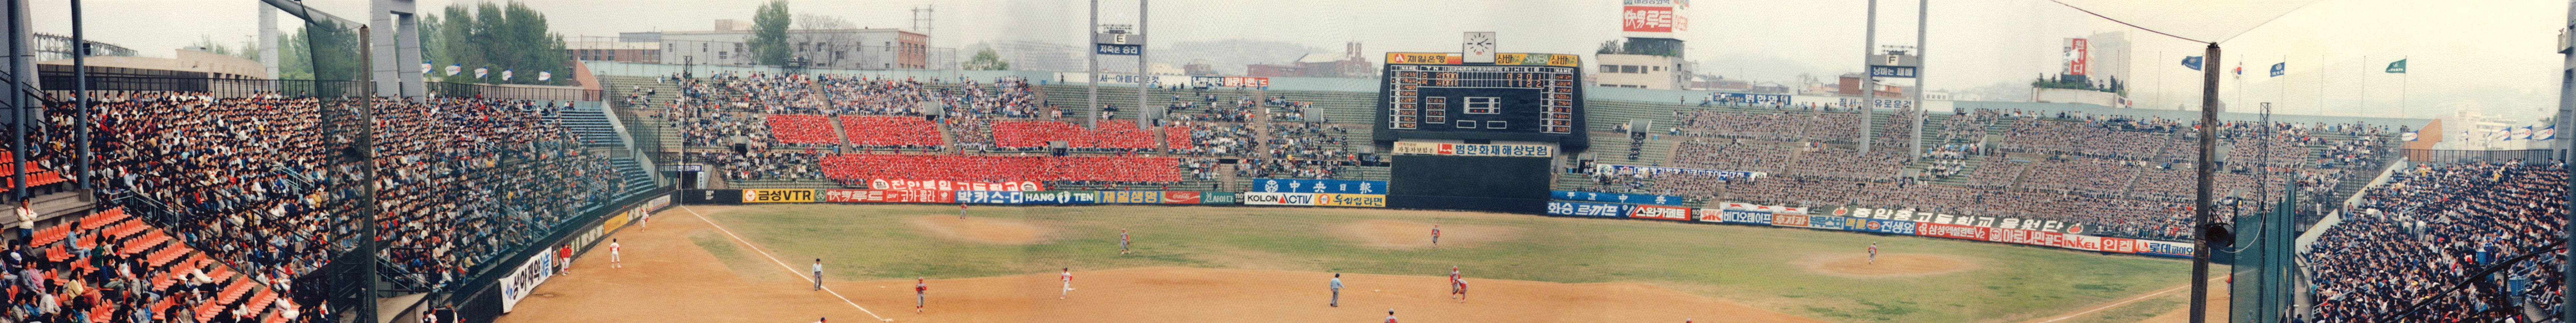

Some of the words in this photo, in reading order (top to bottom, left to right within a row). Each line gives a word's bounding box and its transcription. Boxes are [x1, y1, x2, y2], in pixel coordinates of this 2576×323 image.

[1100, 45, 1120, 53] 저축은
[1525, 54, 1548, 64] SAMBA
[1874, 67, 1894, 75] 낭비는
[1897, 68, 1913, 76] 패배
[1874, 99, 1911, 108] 유로운것
[1456, 144, 1547, 156] 범한화재해상보험
[1289, 180, 1373, 194] 中央日報
[759, 191, 811, 201] 금성VTR
[958, 191, 1023, 203] 박카스-디
[1025, 193, 1055, 202] HANG
[1073, 193, 1094, 202] TEN
[1102, 191, 1157, 203] 제일생명
[1619, 194, 1666, 204] 中央
[1548, 202, 1574, 215] 화승
[1702, 210, 1723, 221] SKC
[1724, 212, 1771, 224] 비디오테이프
[1774, 215, 1807, 225] 후지카
[1845, 218, 1867, 230] 맥콜
[2000, 218, 2063, 233] 응원단
[2103, 239, 2133, 252] 인켈
